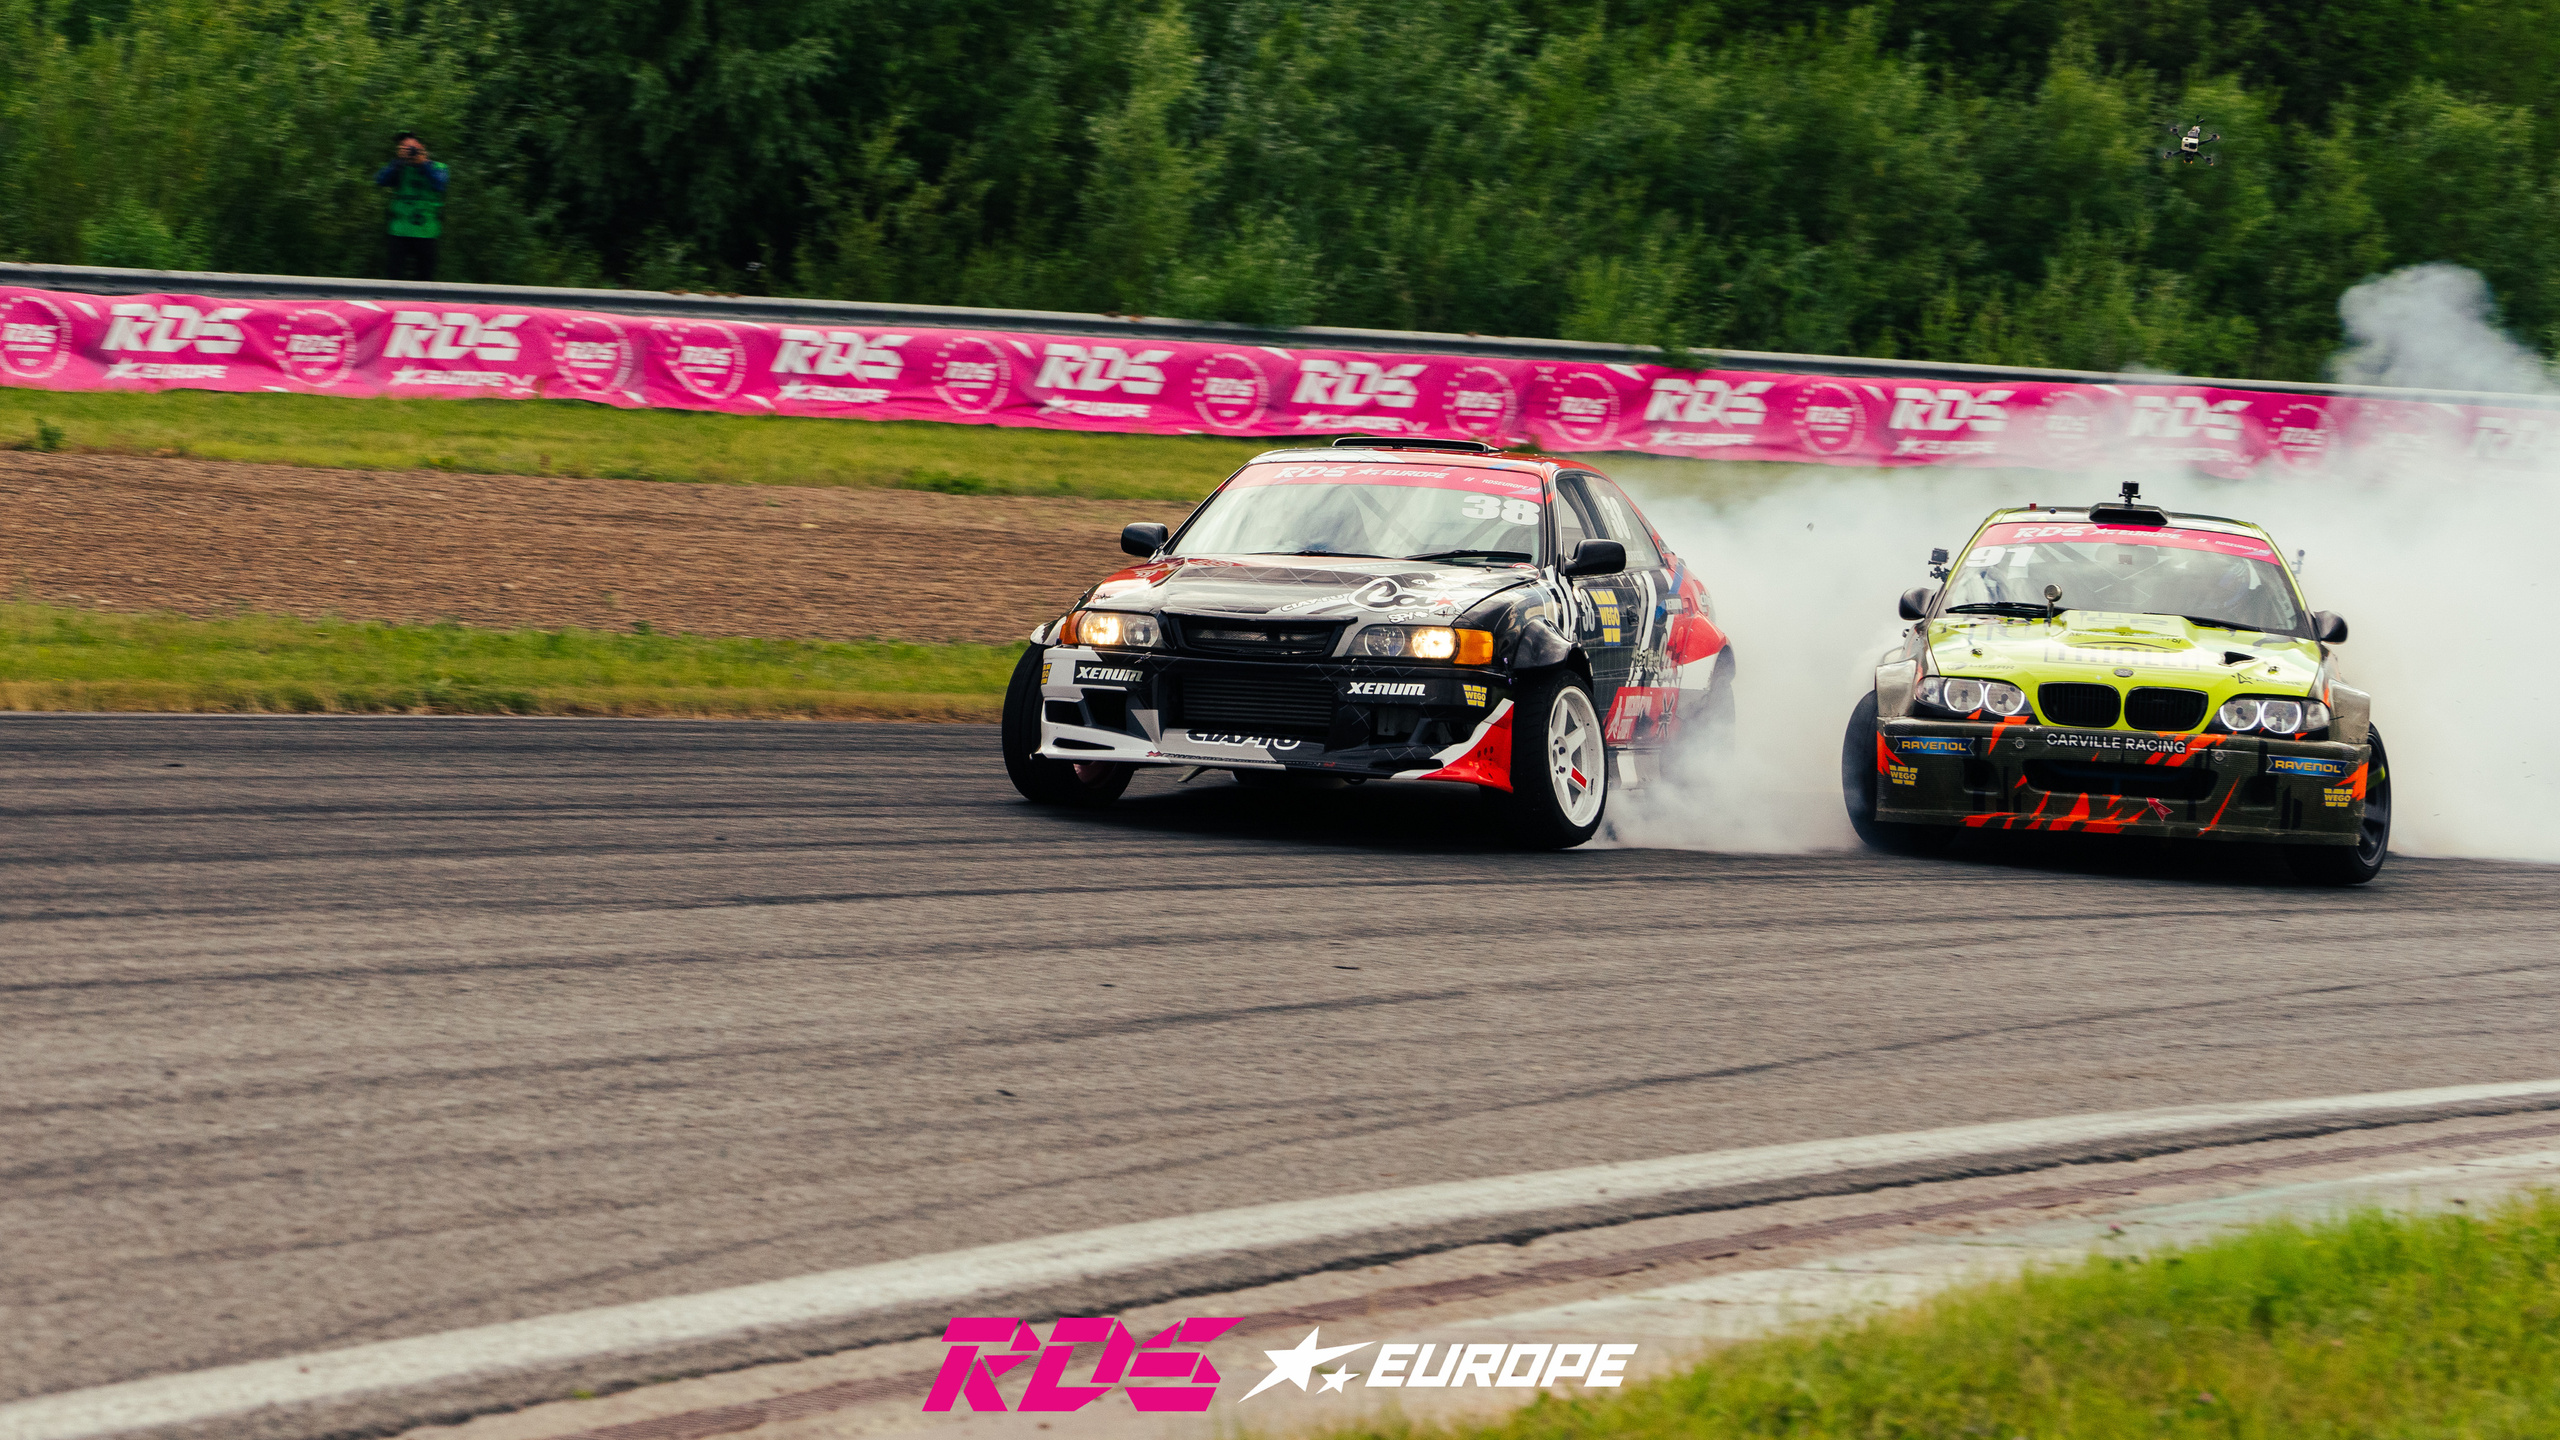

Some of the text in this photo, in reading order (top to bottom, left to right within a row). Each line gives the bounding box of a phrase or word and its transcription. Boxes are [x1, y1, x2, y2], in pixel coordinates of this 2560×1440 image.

[100, 304, 254, 354] RDS
[381, 311, 530, 361] RDS
[769, 329, 914, 381] RDS
[142, 362, 228, 379] EUROPE
[1034, 343, 1176, 395] RDS
[1291, 359, 1428, 408] RDS
[1643, 378, 1776, 425] RDS
[1889, 387, 2017, 431] RDS
[2127, 396, 2254, 440] RDS
[1273, 466, 1356, 479] RDS
[1381, 469, 1450, 479] EUROPE
[1461, 495, 1541, 526] 38
[1600, 495, 1631, 540] 38
[2013, 526, 2090, 539] RDS
[2118, 530, 2183, 539] EUROPE
[1965, 546, 2036, 568] 91
[1573, 588, 1595, 632] 38
[1598, 606, 1621, 627] WEGO
[1076, 666, 1143, 682] XENUM
[1347, 682, 1426, 696] XENUM
[1465, 691, 1487, 701] WEGO
[1901, 740, 1967, 751] RAVENOL
[2046, 733, 2186, 754] CARVILLE RACING
[1890, 771, 1917, 780] WEGO
[2275, 760, 2342, 774] RAVENOL
[2324, 794, 2351, 802] WEGO
